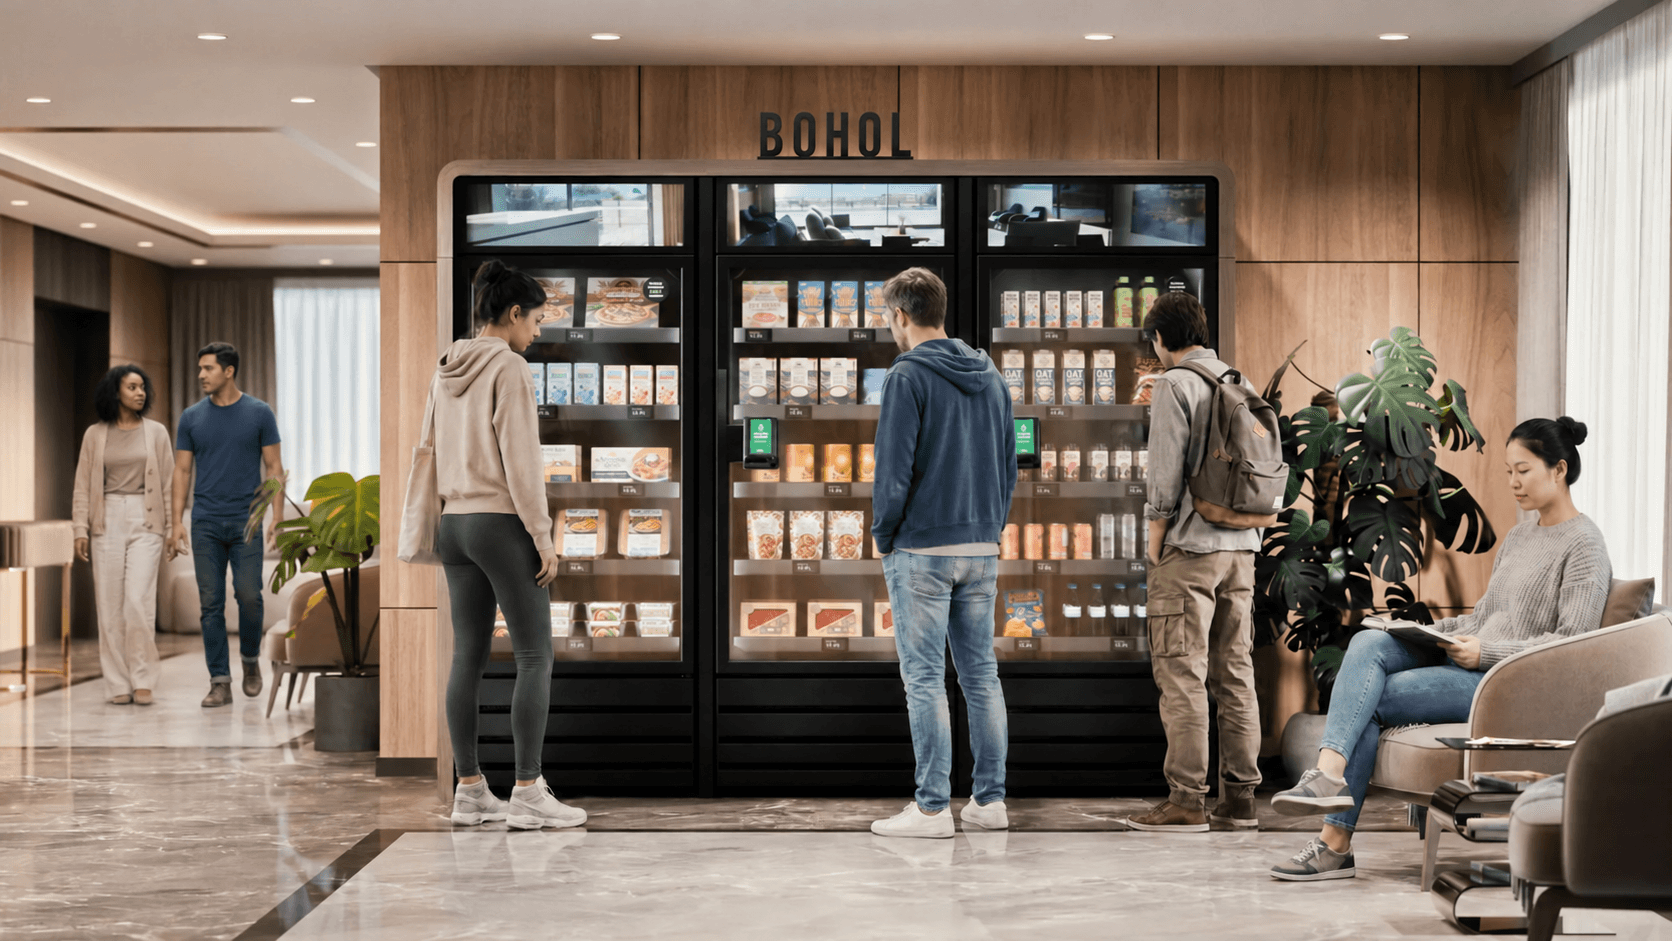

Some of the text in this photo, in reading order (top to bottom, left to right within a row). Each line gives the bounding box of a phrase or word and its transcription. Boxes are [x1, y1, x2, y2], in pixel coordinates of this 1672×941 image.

[760, 111, 911, 157] BOHOL
[1004, 369, 1022, 378] OAT
[1035, 369, 1053, 378] OAT
[1066, 369, 1083, 378] OAT
[1096, 369, 1113, 378] OAT
